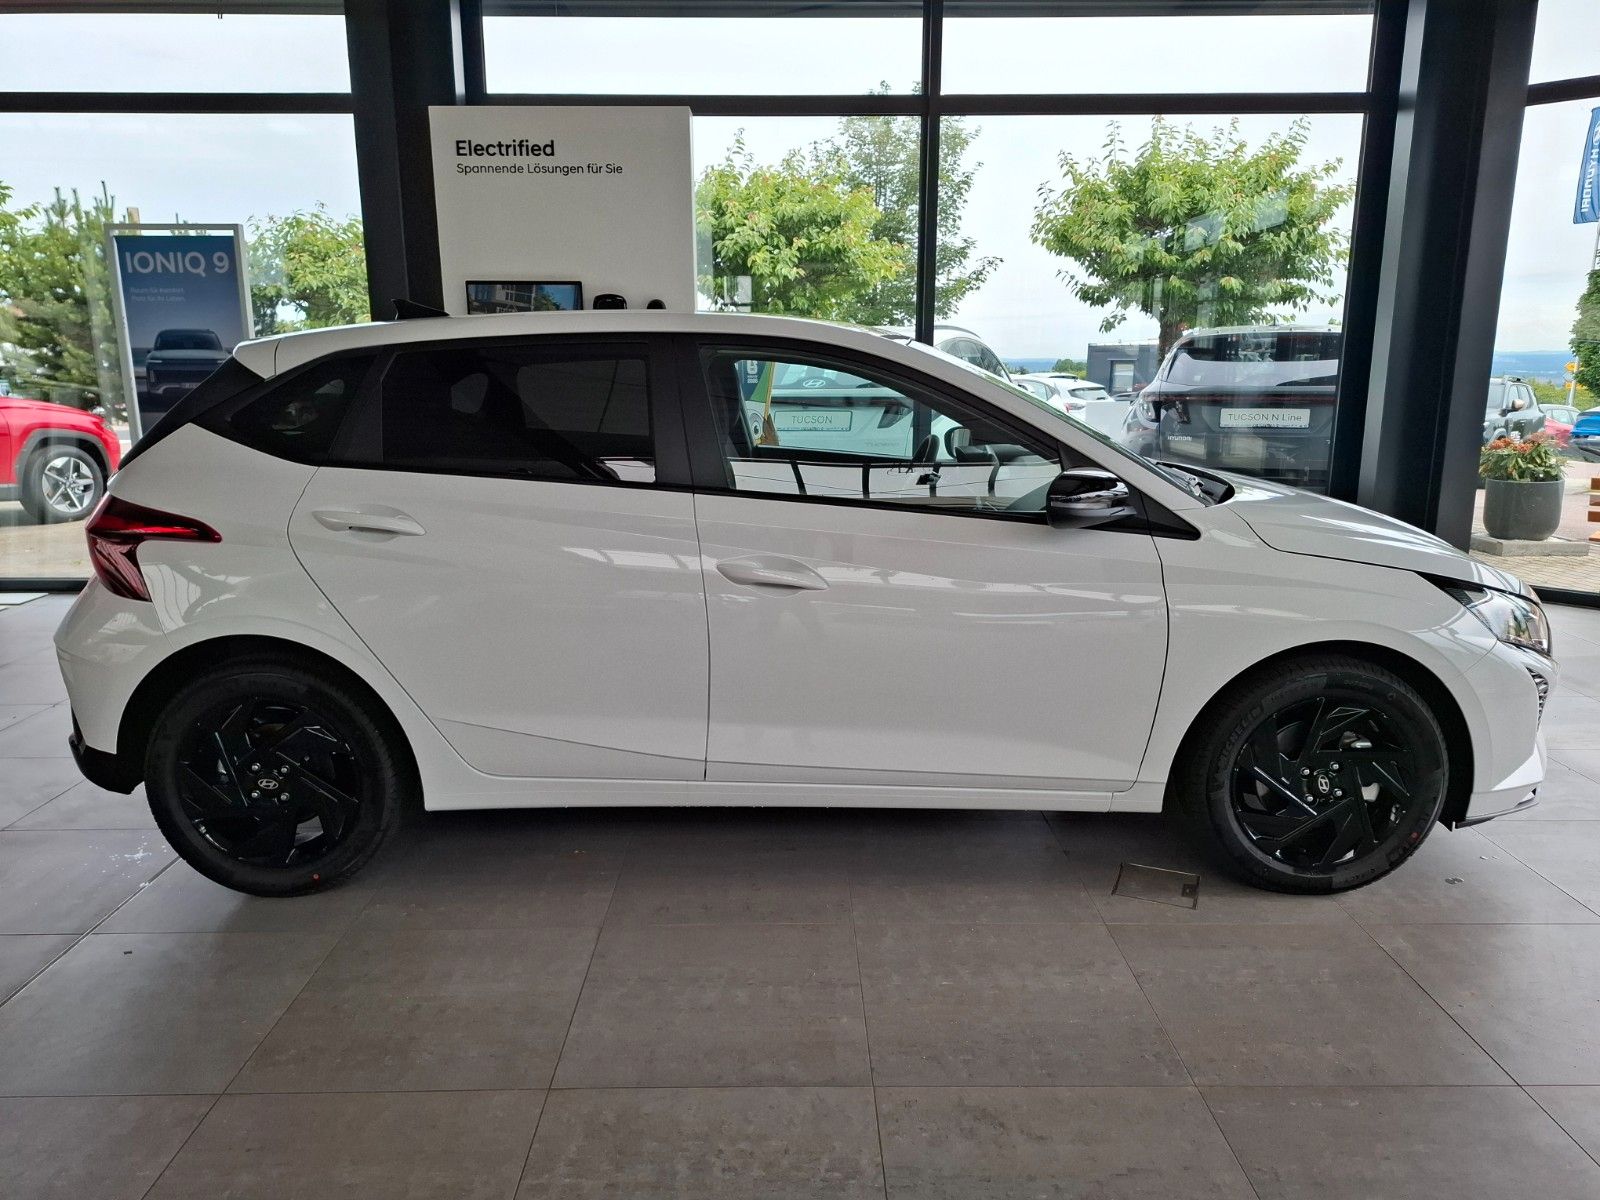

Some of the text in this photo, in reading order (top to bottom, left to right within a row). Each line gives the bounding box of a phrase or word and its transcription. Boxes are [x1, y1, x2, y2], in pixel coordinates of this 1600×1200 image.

[455, 139, 555, 157] Electrified
[456, 162, 623, 176] Spannende Lösungen für Sie
[125, 251, 230, 277] IONIQ 9
[791, 415, 833, 425] TUCSON
[1228, 413, 1302, 421] TUCSON N Line
